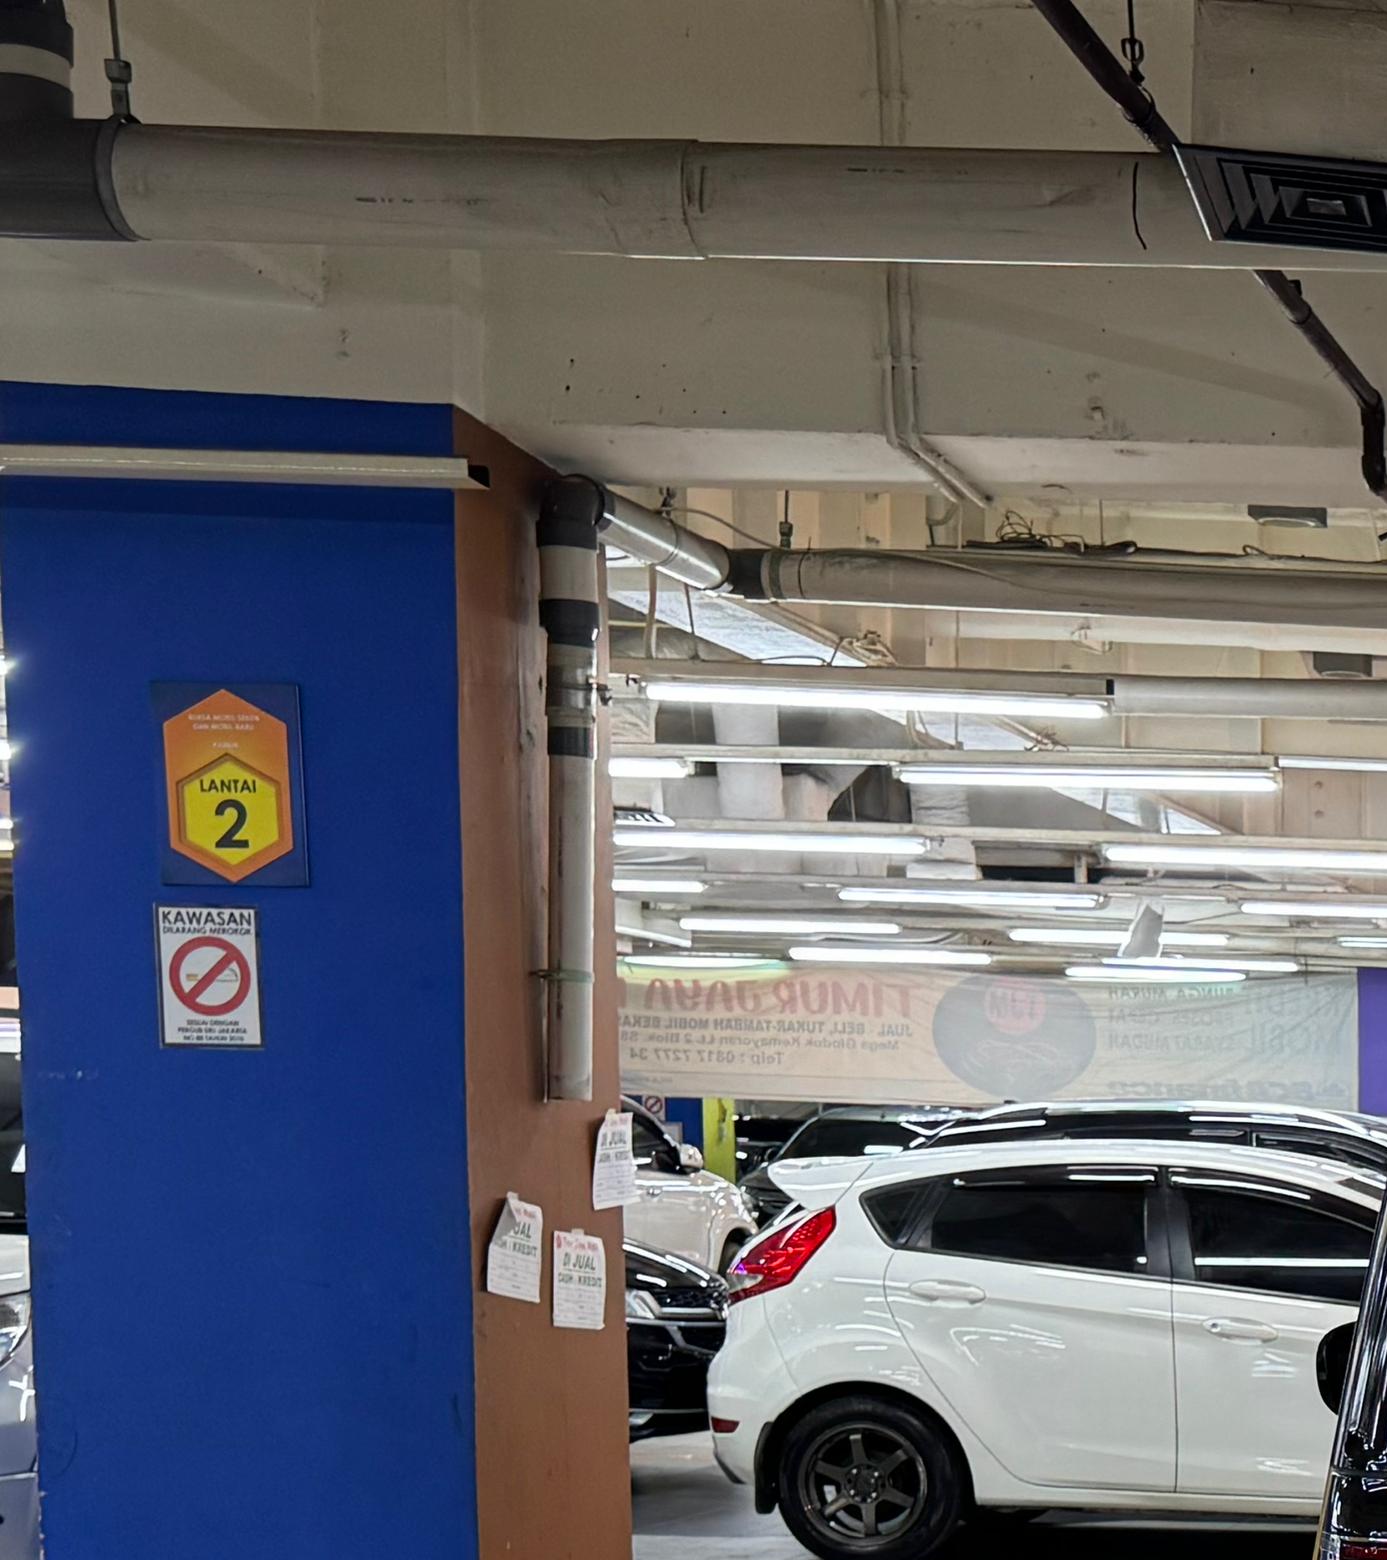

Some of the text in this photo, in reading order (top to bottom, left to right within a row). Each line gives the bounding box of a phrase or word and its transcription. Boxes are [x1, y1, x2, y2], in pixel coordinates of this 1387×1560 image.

[199, 778, 257, 794] LANTAI
[214, 798, 250, 849] 2
[161, 910, 252, 927] KAWASAN
[162, 926, 207, 935] DILARANG
[572, 1254, 596, 1272] JUAL
